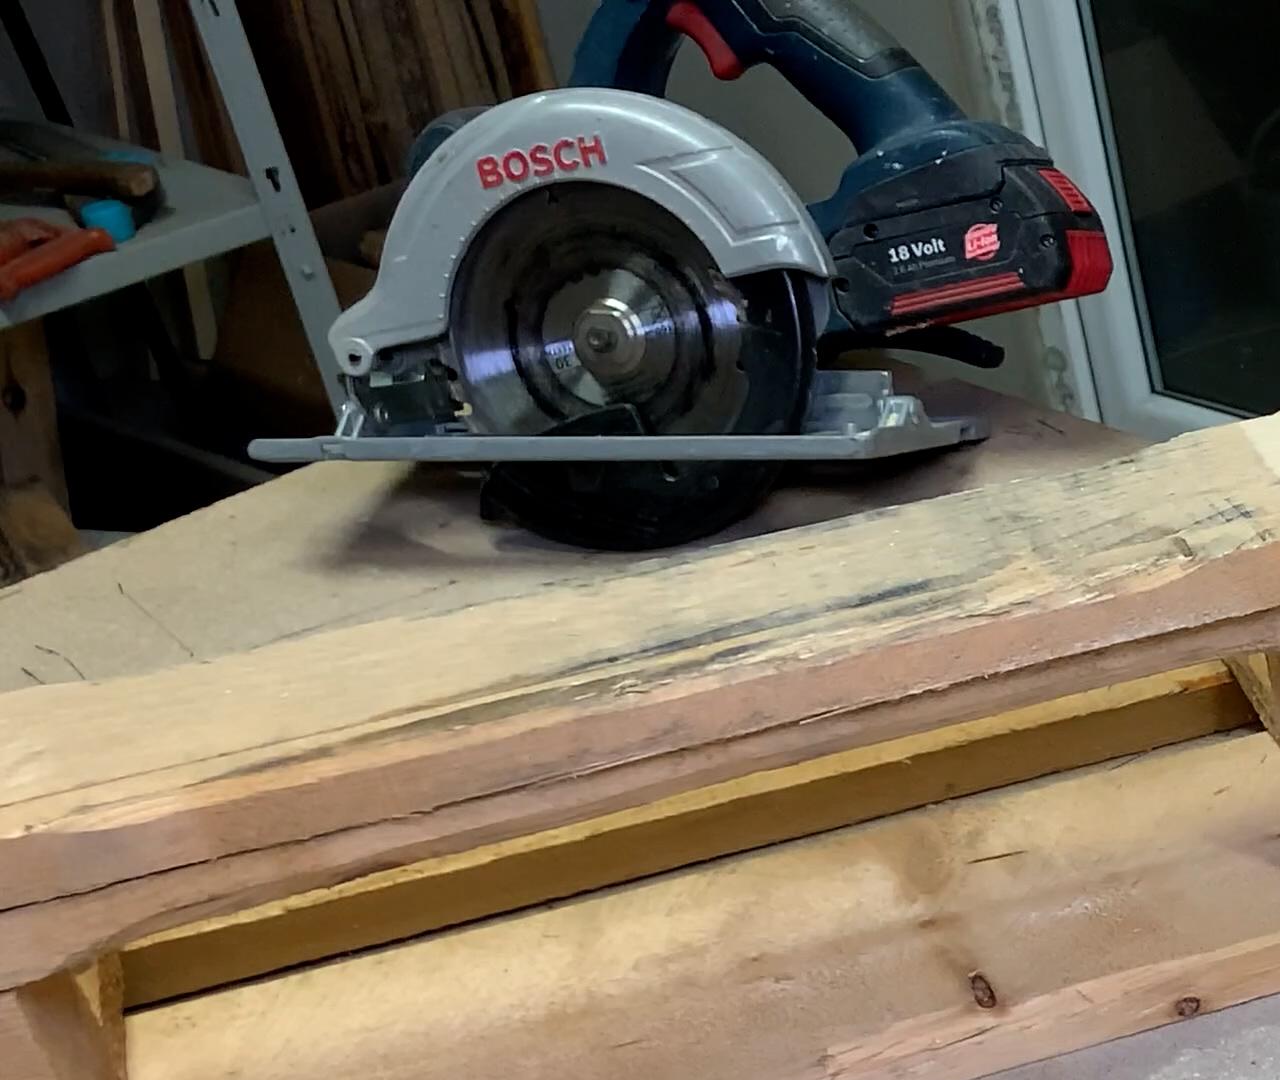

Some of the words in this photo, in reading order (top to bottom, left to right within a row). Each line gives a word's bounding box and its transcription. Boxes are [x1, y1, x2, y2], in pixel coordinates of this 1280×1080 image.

[476, 134, 607, 190] BOSCH
[887, 245, 911, 263] 18
[911, 237, 947, 258] Volt
